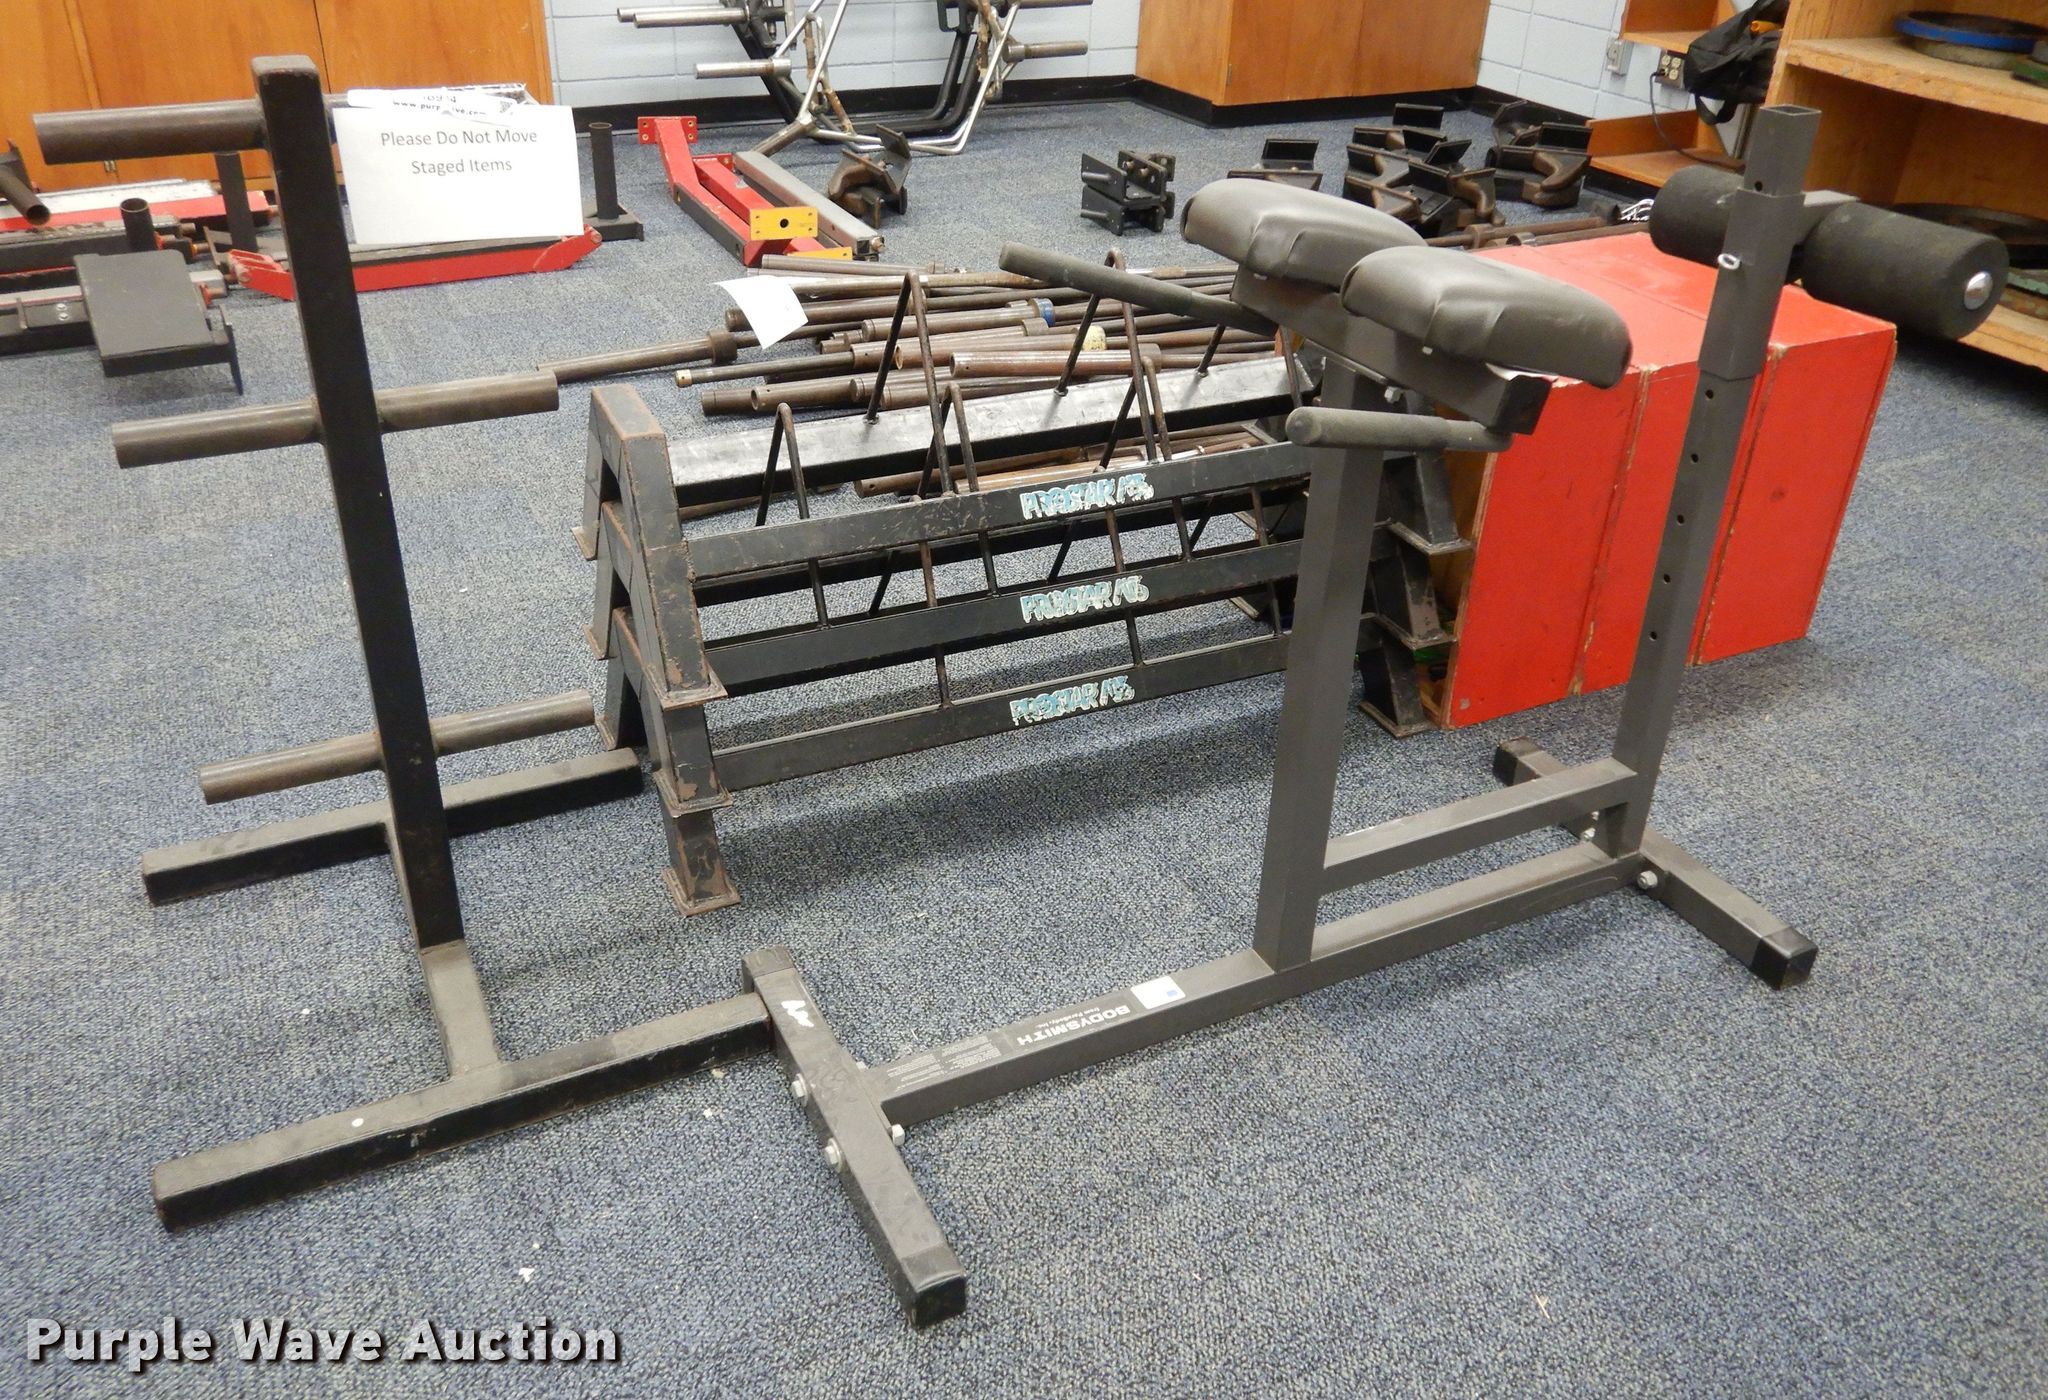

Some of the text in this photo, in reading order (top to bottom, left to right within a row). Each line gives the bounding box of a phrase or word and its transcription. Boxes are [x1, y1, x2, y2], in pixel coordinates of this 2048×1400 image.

[381, 129, 538, 147] Please Do Not Move
[412, 159, 512, 176] Staged Items
[1016, 1005, 1131, 1046] BODYSMITH
